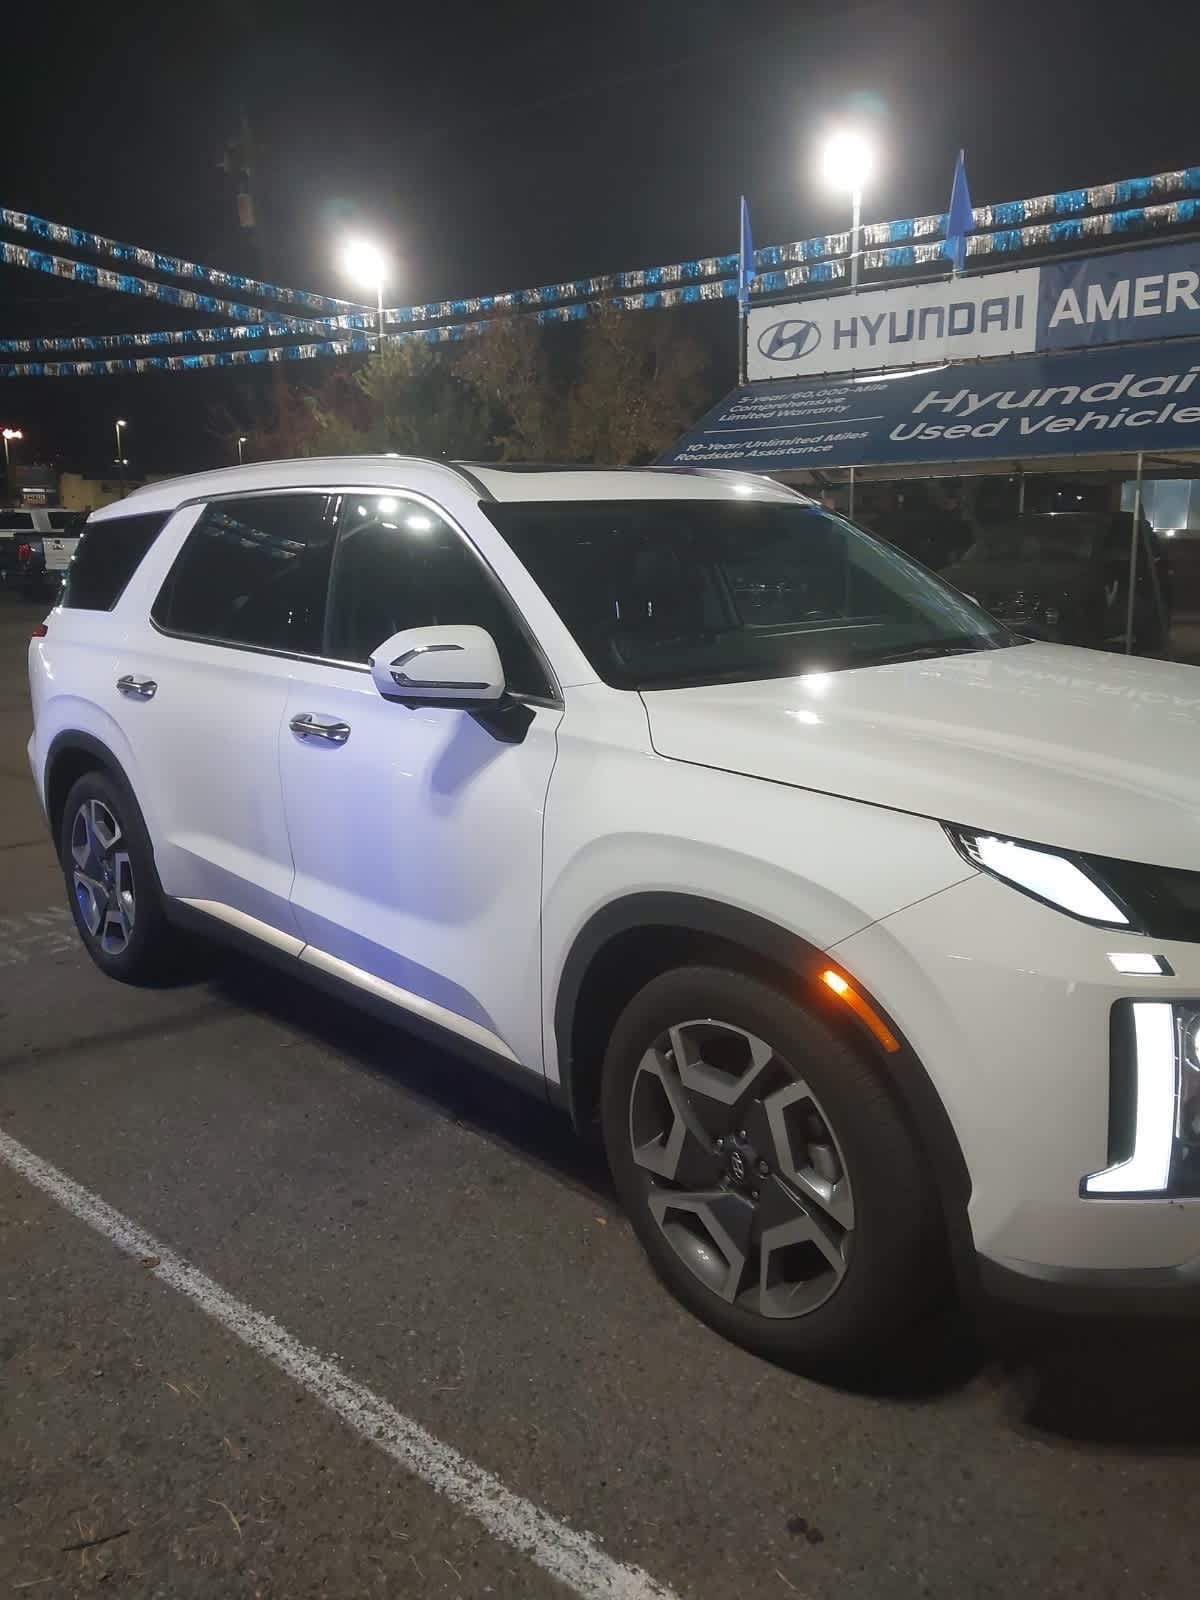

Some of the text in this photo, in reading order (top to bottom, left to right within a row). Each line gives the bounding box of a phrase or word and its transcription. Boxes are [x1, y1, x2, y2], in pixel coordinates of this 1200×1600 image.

[1048, 271, 1200, 328] AMER
[833, 295, 1025, 350] HYUNDAI
[730, 397, 846, 412] Comprehensive
[912, 366, 1200, 416] Hyundai
[719, 405, 850, 421] Limited Warranty
[889, 403, 1200, 441] Used Vehicle
[823, 431, 870, 442] Miles
[674, 444, 833, 461] Roadside Assistance
